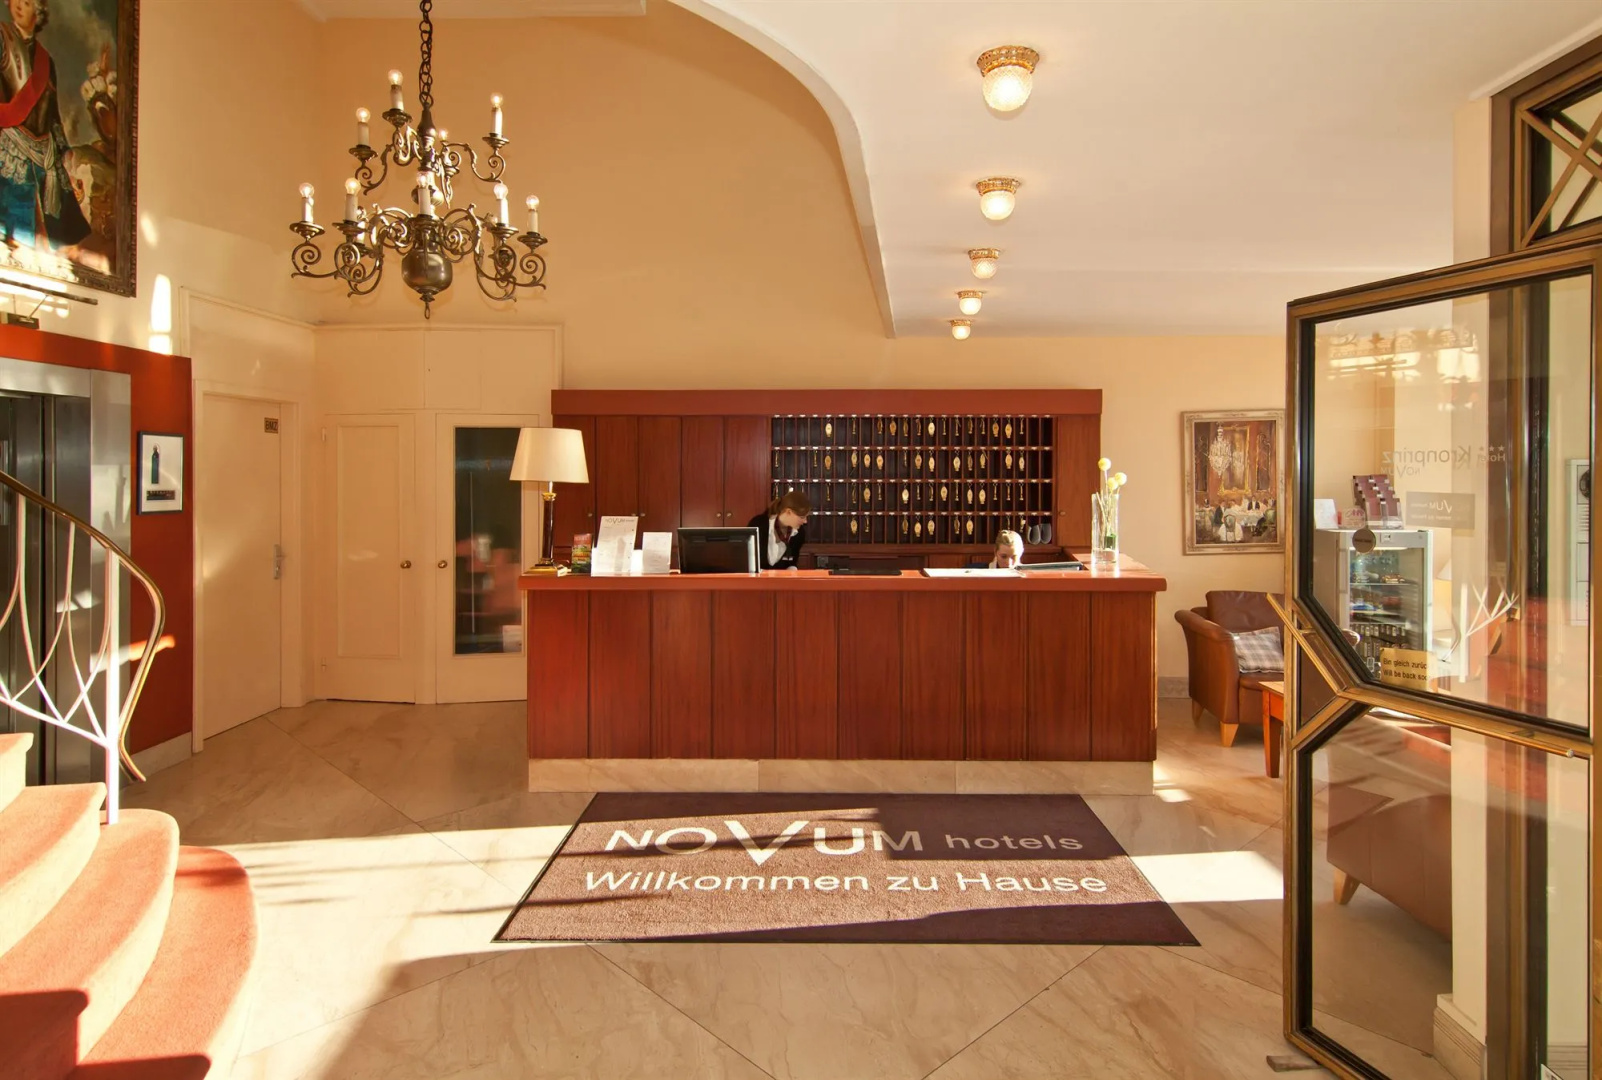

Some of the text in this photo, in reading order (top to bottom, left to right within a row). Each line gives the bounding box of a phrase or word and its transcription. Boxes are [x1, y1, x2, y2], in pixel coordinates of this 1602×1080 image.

[605, 820, 1083, 866] NOVUM hotels
[586, 871, 1107, 892] Willkommen zu Hause
